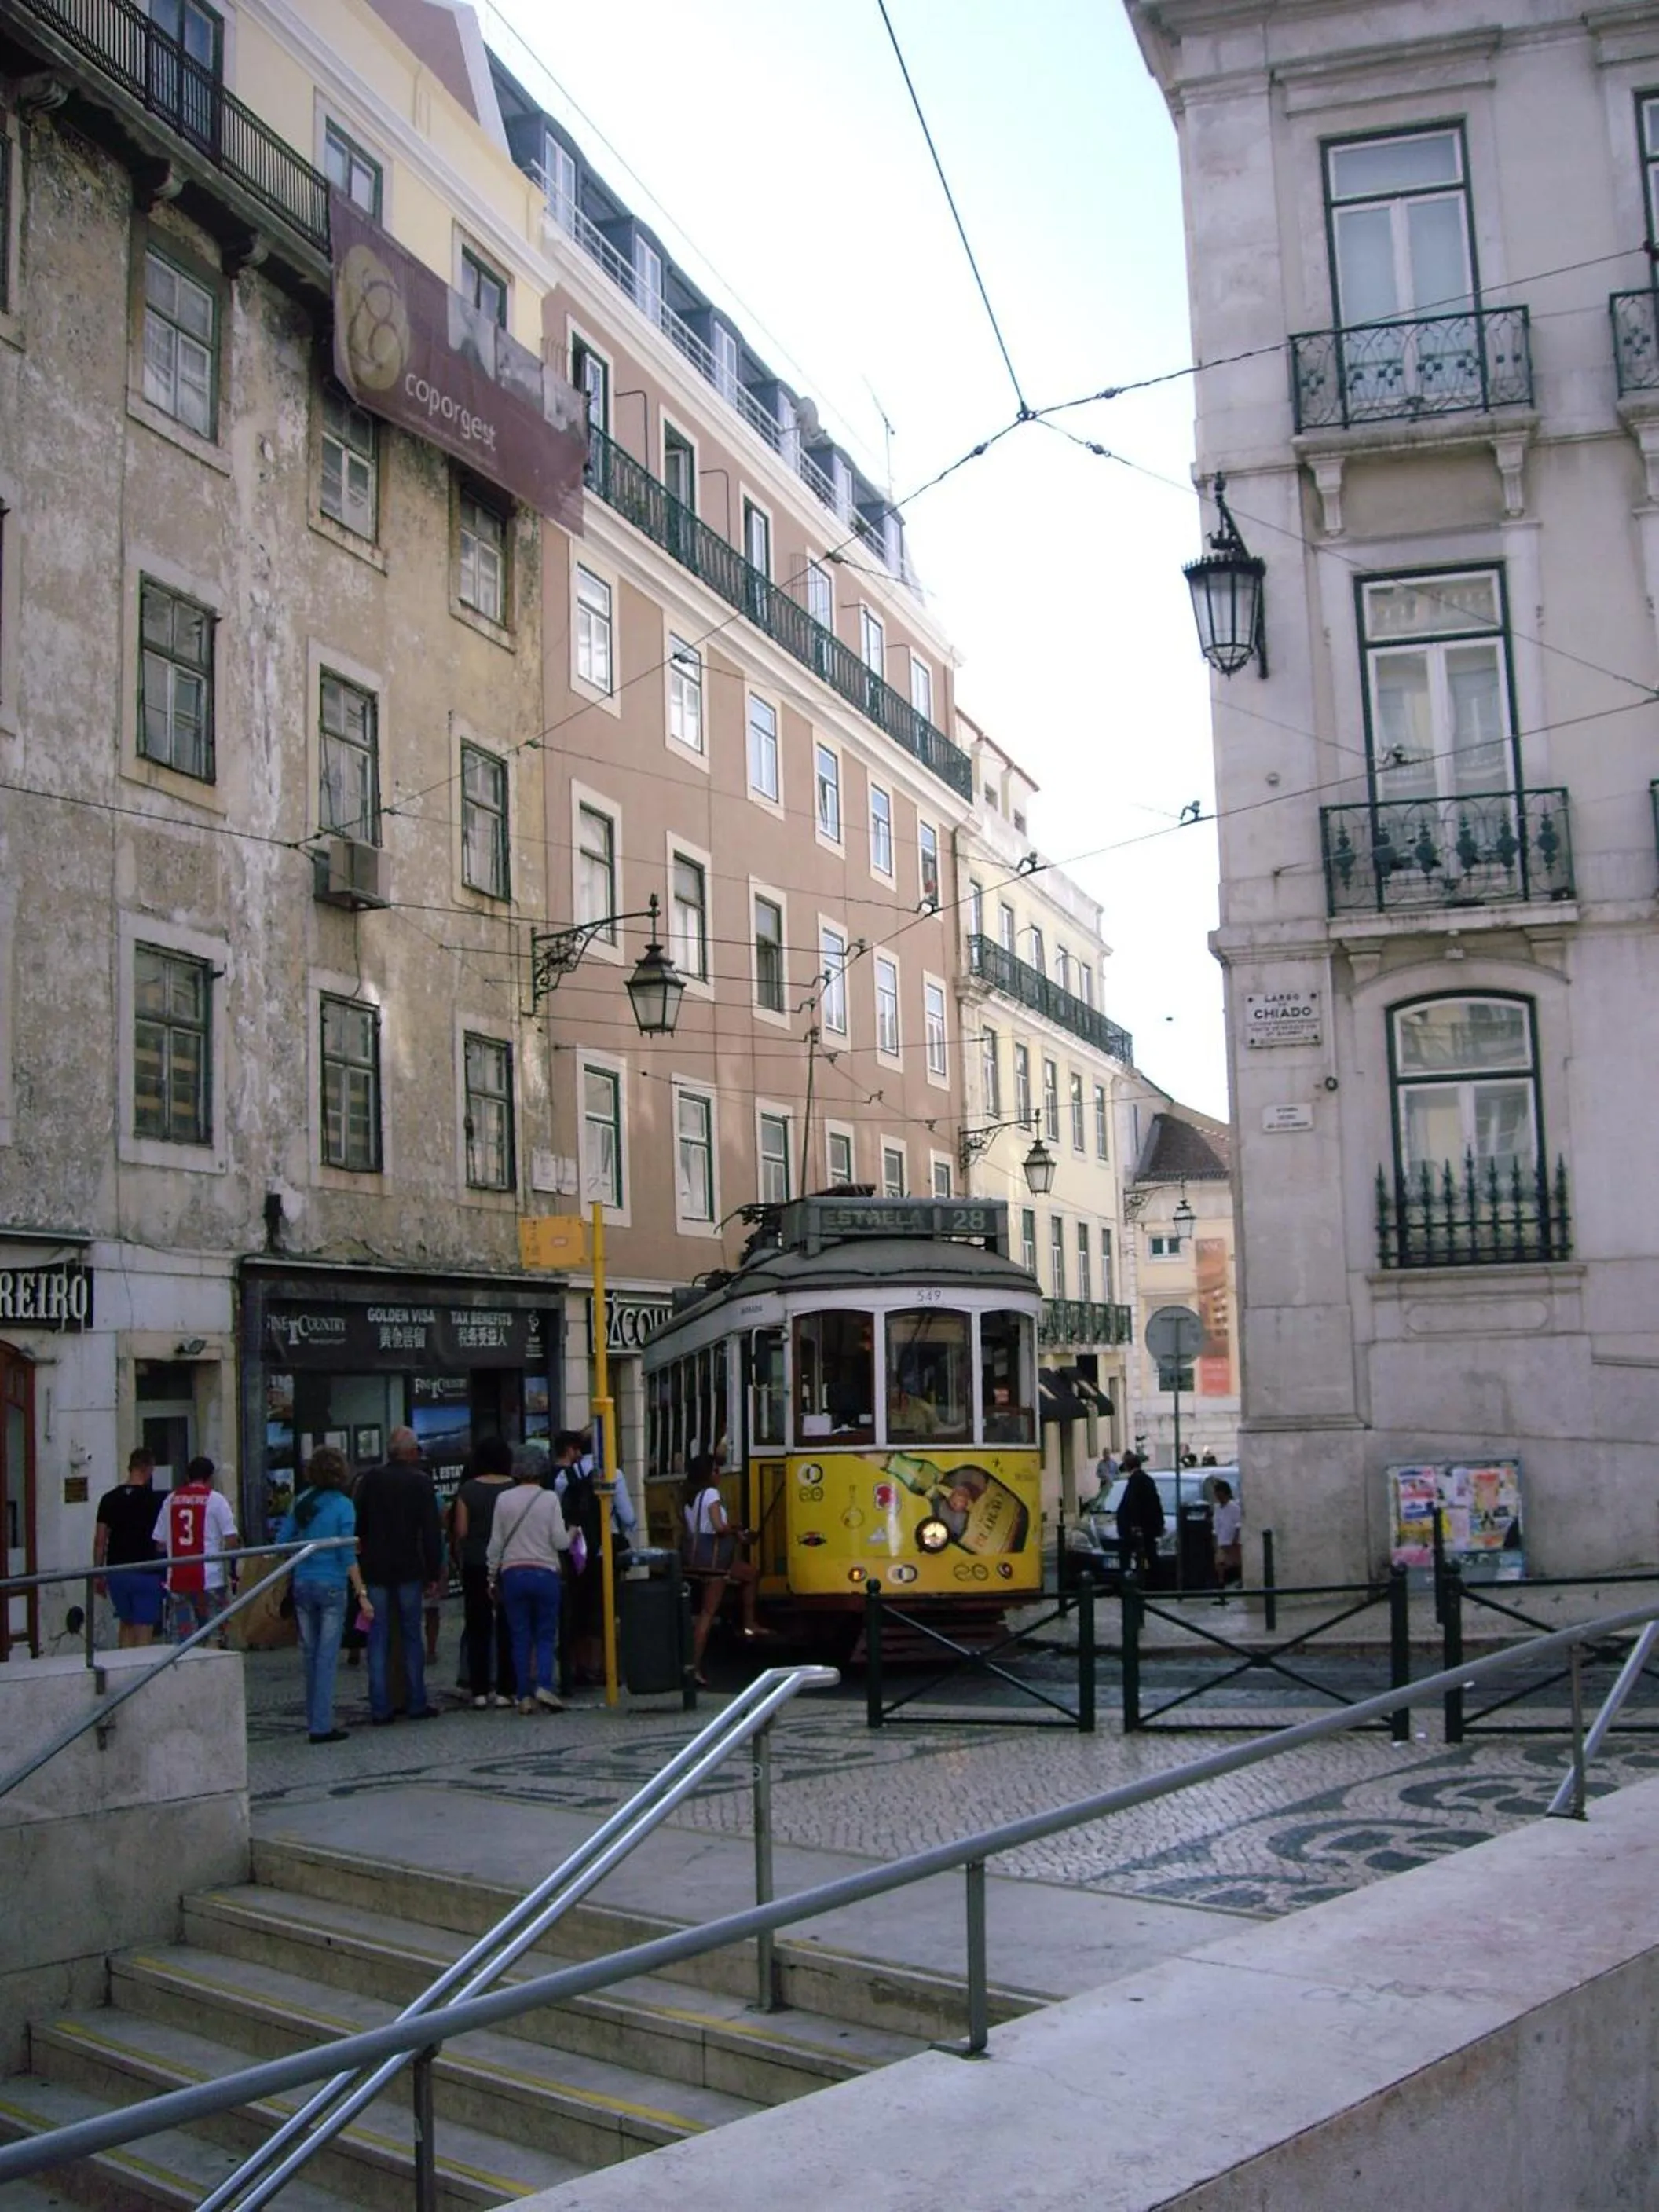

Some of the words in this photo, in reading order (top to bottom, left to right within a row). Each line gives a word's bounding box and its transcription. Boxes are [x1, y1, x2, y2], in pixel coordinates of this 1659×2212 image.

[405, 372, 496, 452] coporgest
[1254, 1006, 1312, 1020] CHIADO
[826, 1208, 925, 1228] ESTRELA
[952, 1209, 987, 1230] 28
[916, 1288, 942, 1302] 549
[367, 1306, 409, 1324] GOLDEN
[411, 1308, 436, 1324] VISA
[450, 1310, 469, 1326] TAX
[471, 1311, 513, 1326] BENEFITS
[178, 1508, 194, 1546] 3
